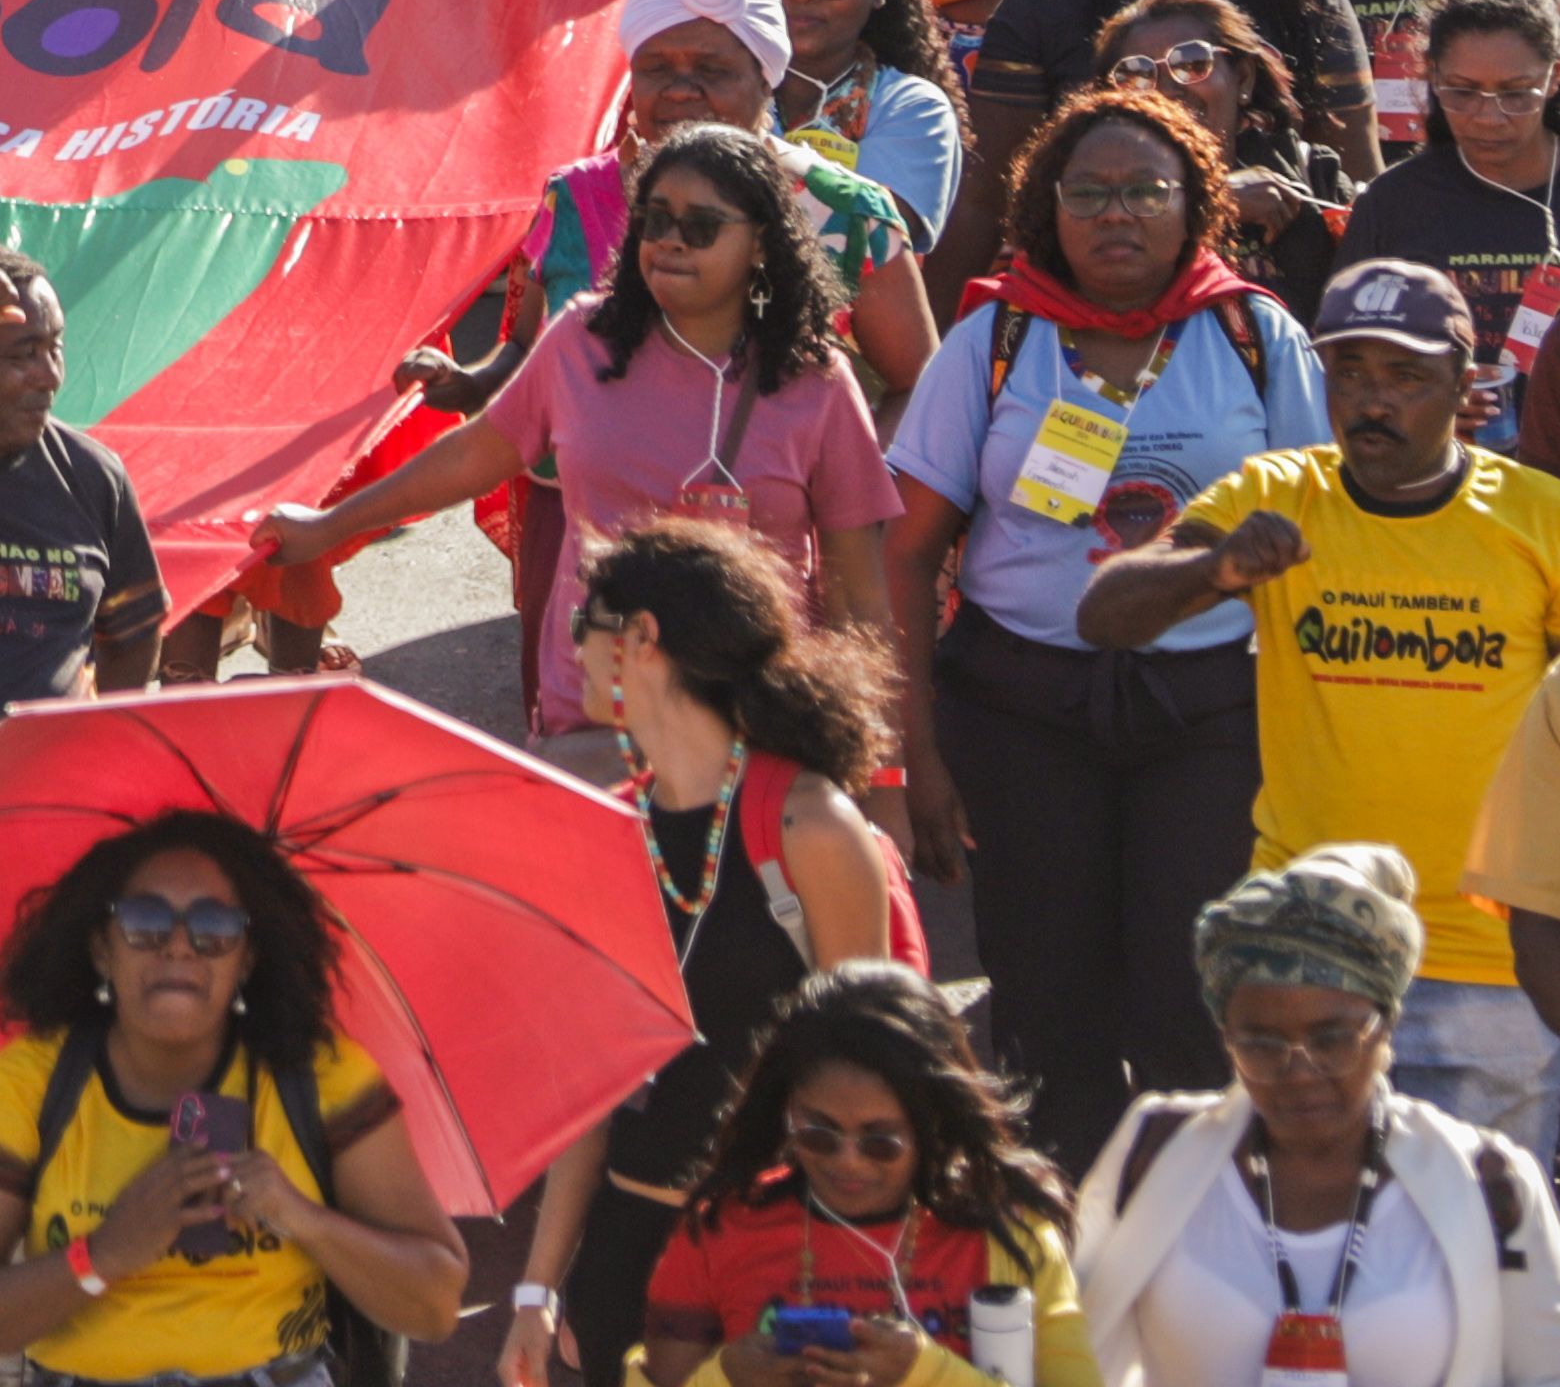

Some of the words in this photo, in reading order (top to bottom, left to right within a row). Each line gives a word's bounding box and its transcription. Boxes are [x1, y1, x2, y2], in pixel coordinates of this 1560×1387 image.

[54, 88, 323, 164] HISTÓRIA
[1322, 590, 1336, 605] O
[1340, 591, 1386, 608] PIAUÍ
[1389, 593, 1464, 613] TAMBÉM
[1464, 597, 1481, 614] É
[1294, 605, 1508, 673] Quilombola
